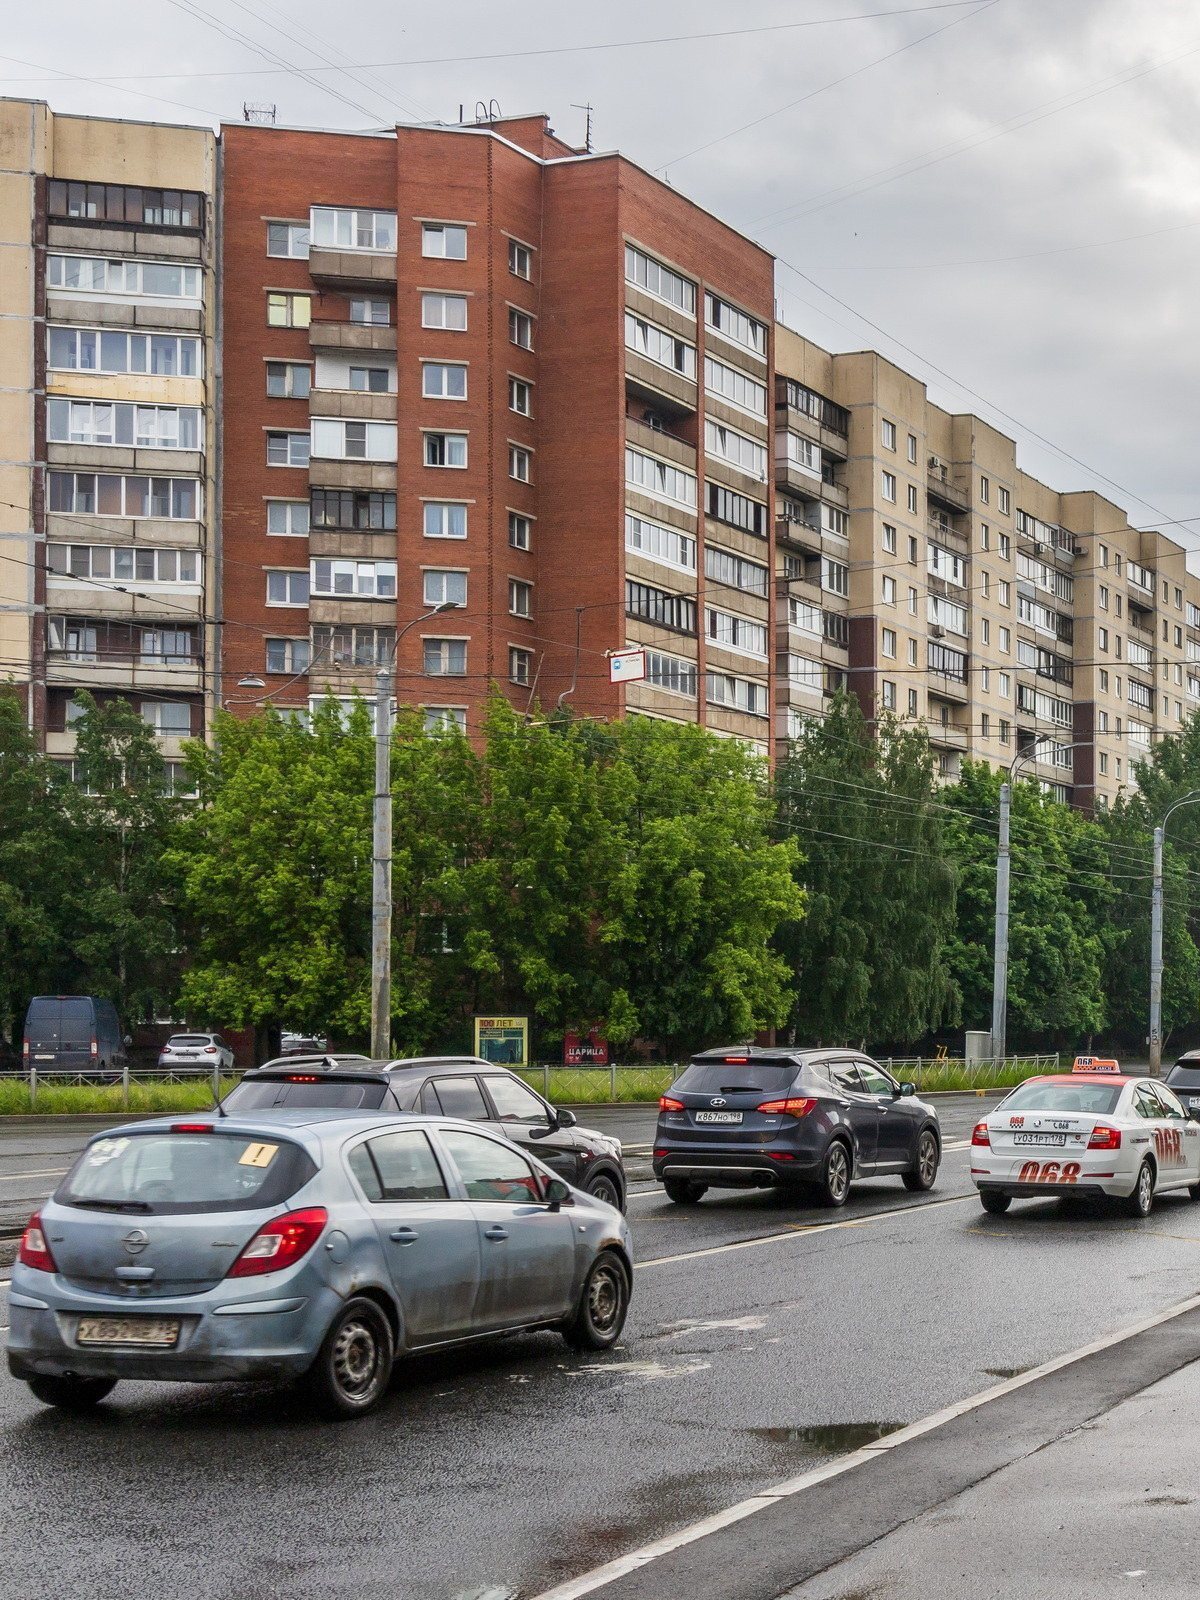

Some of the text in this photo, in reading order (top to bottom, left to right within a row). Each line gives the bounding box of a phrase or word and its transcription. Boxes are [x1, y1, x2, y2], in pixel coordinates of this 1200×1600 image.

[496, 1019, 514, 1027] ЛЕТ
[568, 1048, 604, 1057] ЦАРИЦА
[1077, 1057, 1093, 1066] 068
[697, 1111, 741, 1121] К867НО 198
[1009, 1116, 1025, 1124] 068
[1017, 1133, 1063, 1143] У031РТ 178
[1018, 1160, 1081, 1184] 068
